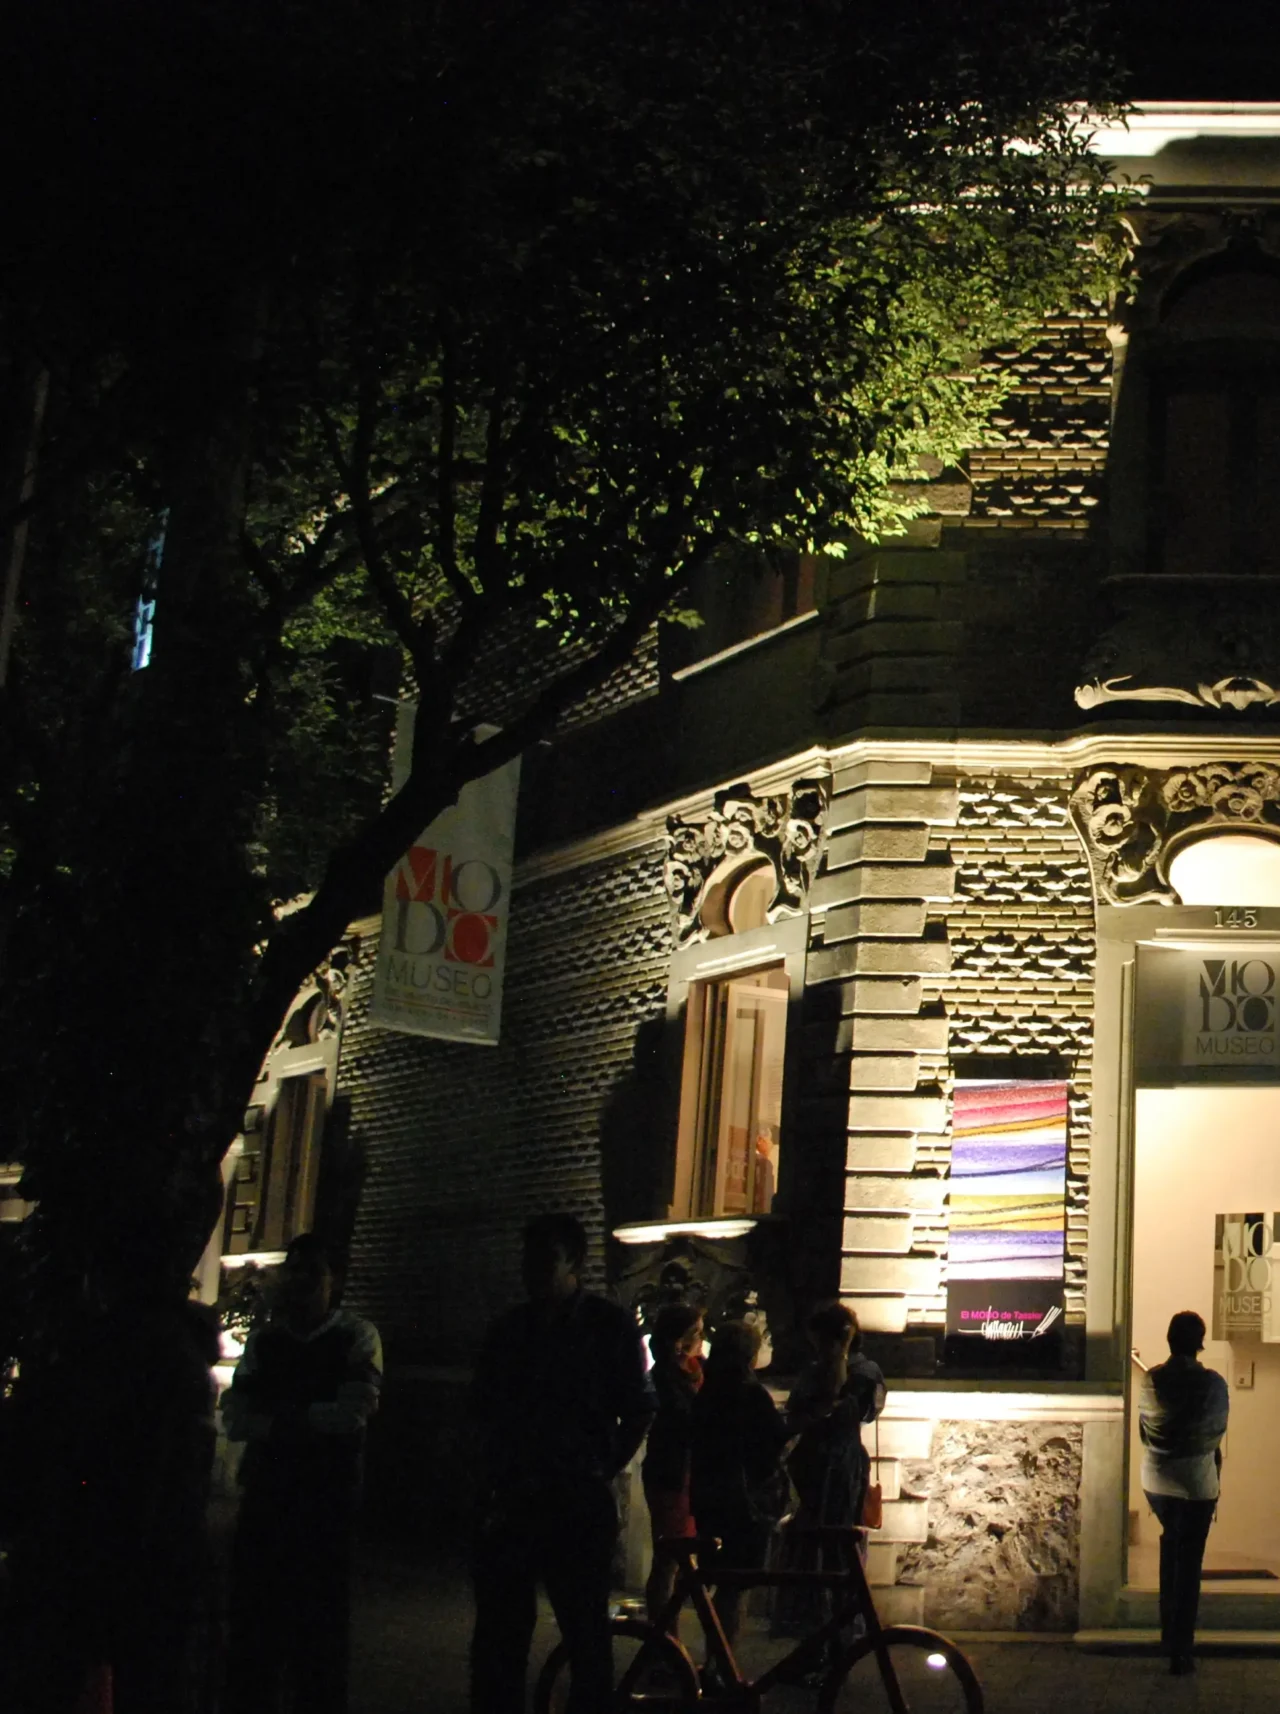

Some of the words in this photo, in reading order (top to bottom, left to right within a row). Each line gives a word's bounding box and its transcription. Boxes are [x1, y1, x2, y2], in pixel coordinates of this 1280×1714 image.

[1213, 909, 1258, 929] 145
[385, 954, 493, 999] MUSEO
[1196, 1036, 1275, 1055] MUSEO
[971, 1310, 1000, 1320] MODO
[1001, 1310, 1012, 1320] de
[1219, 1295, 1273, 1315] MUSEO
